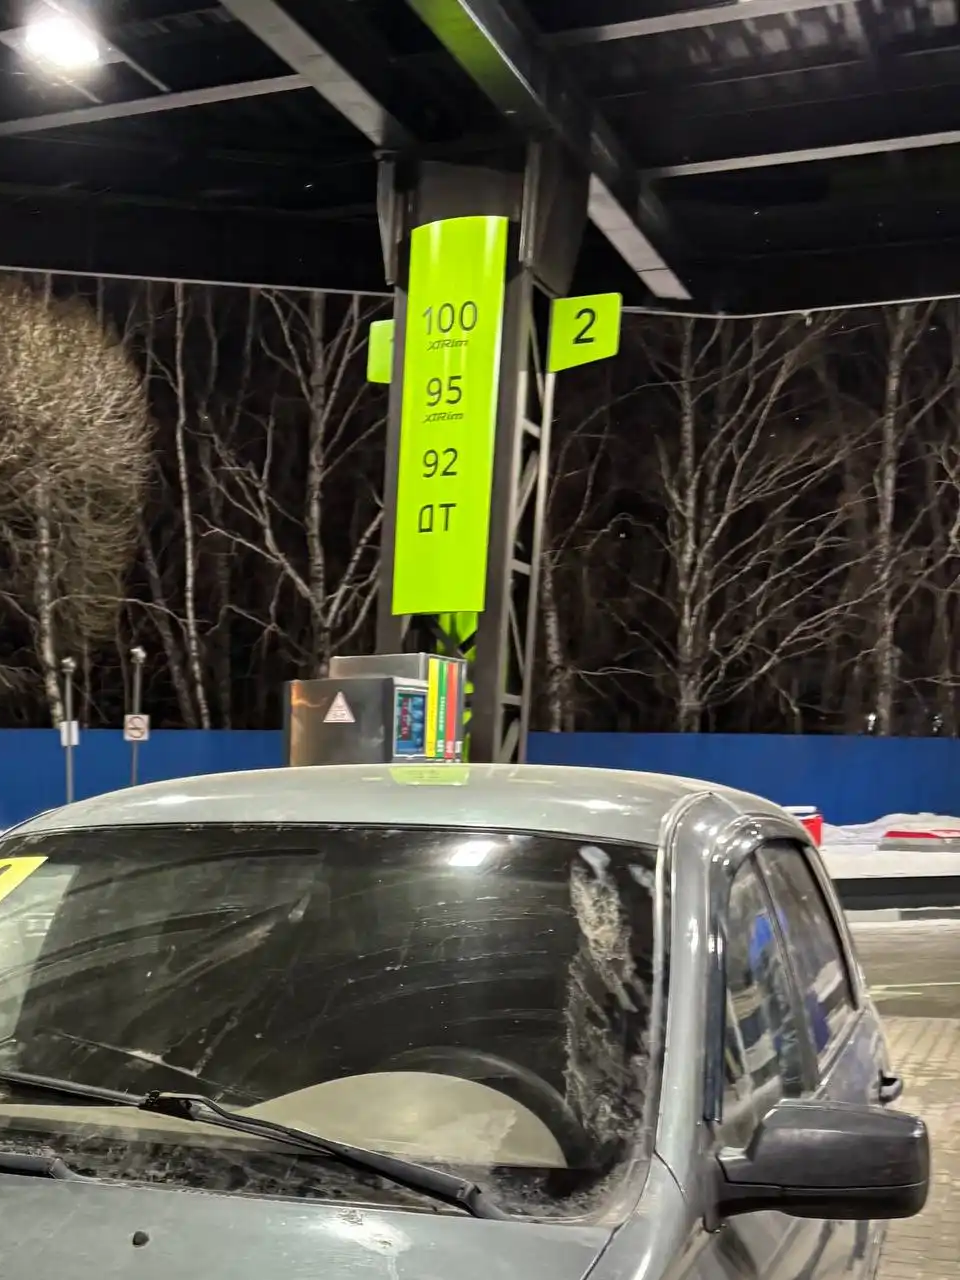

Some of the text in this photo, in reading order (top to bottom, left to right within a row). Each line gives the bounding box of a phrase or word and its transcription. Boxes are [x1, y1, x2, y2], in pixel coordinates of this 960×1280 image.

[421, 299, 479, 337] 100
[572, 307, 598, 345] 2
[426, 375, 463, 408] 95
[422, 447, 459, 479] 92
